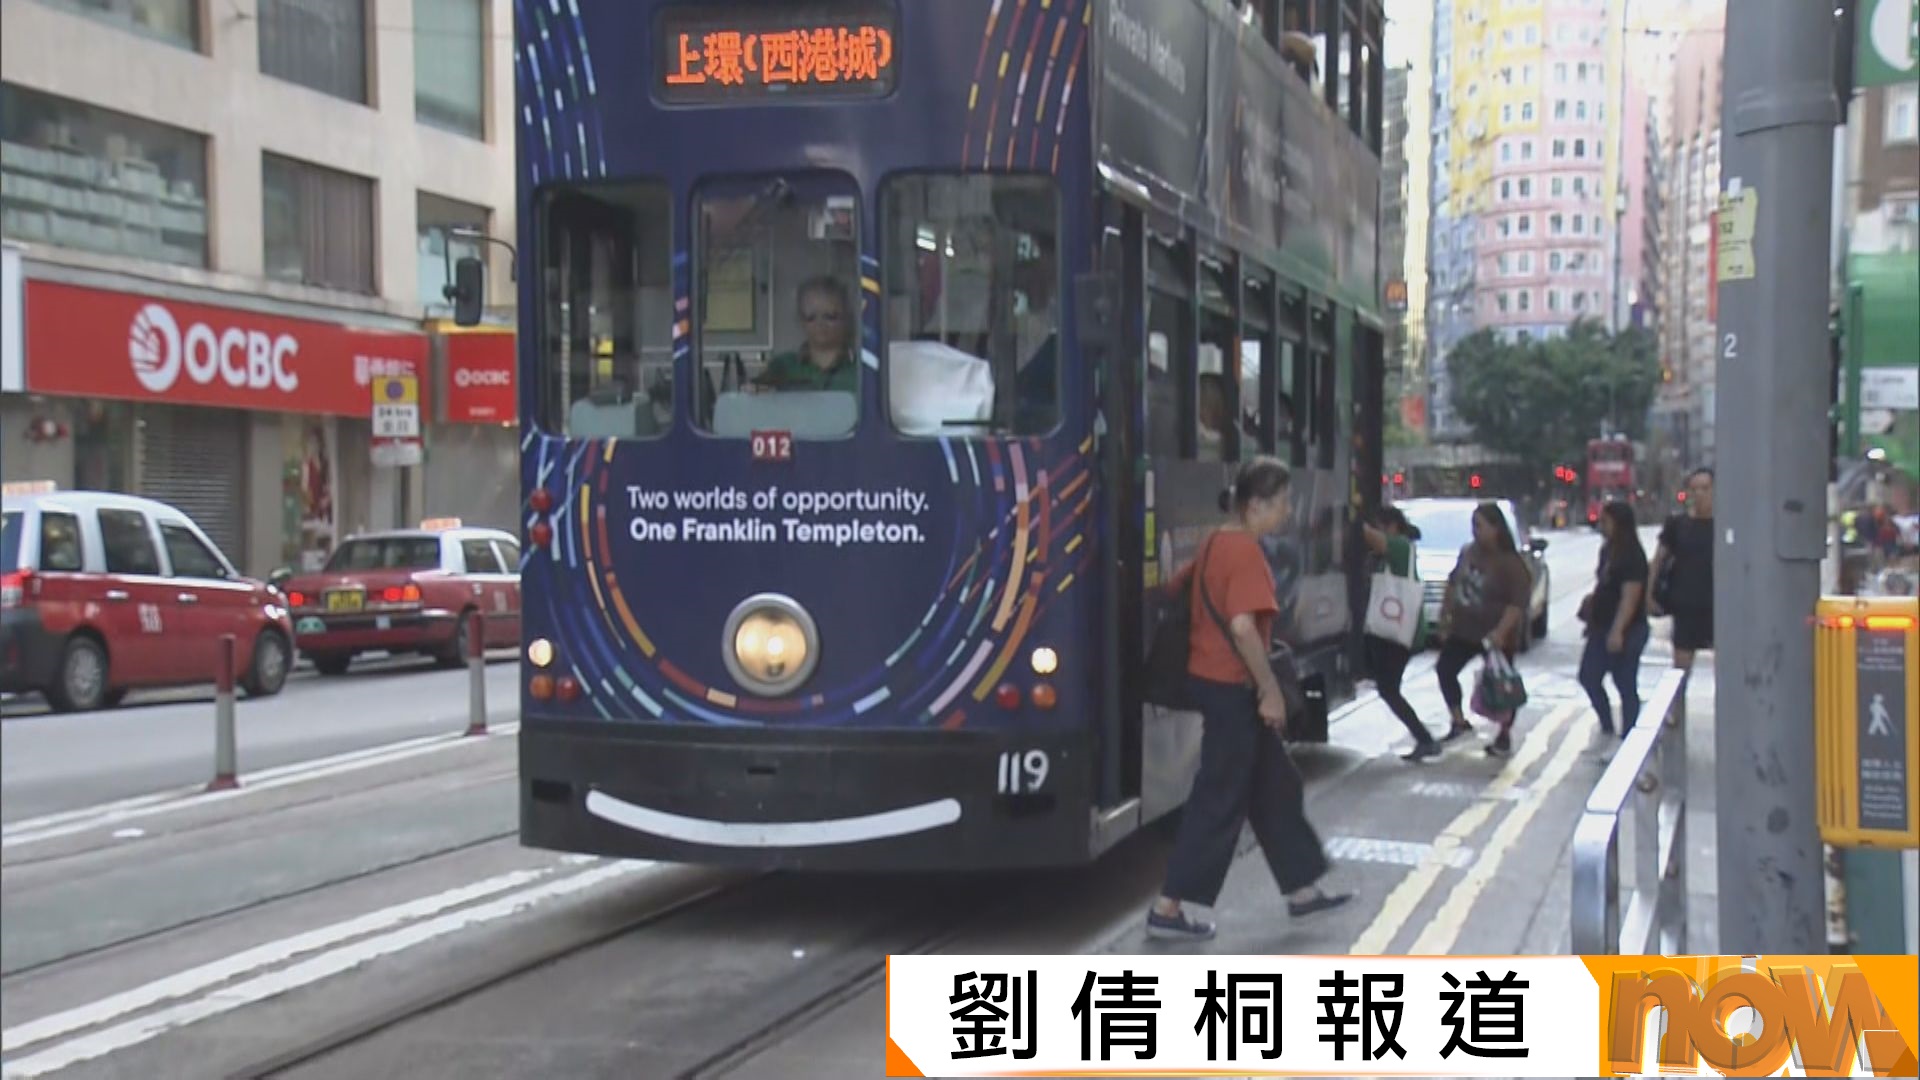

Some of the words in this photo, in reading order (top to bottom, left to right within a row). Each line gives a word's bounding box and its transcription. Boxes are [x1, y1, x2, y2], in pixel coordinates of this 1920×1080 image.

[666, 26, 892, 85] 上環(西港城)
[184, 322, 299, 392] OCBC
[1723, 332, 1737, 359] 2
[470, 369, 510, 386] OCBC
[752, 436, 791, 457] 012
[626, 486, 669, 510] Two
[673, 486, 747, 510] worlds
[752, 486, 778, 510] of
[782, 487, 929, 515] opportunity.
[629, 517, 677, 541] One
[682, 518, 777, 542] Franklin
[782, 518, 926, 547] Templeton.
[998, 749, 1049, 794] 119
